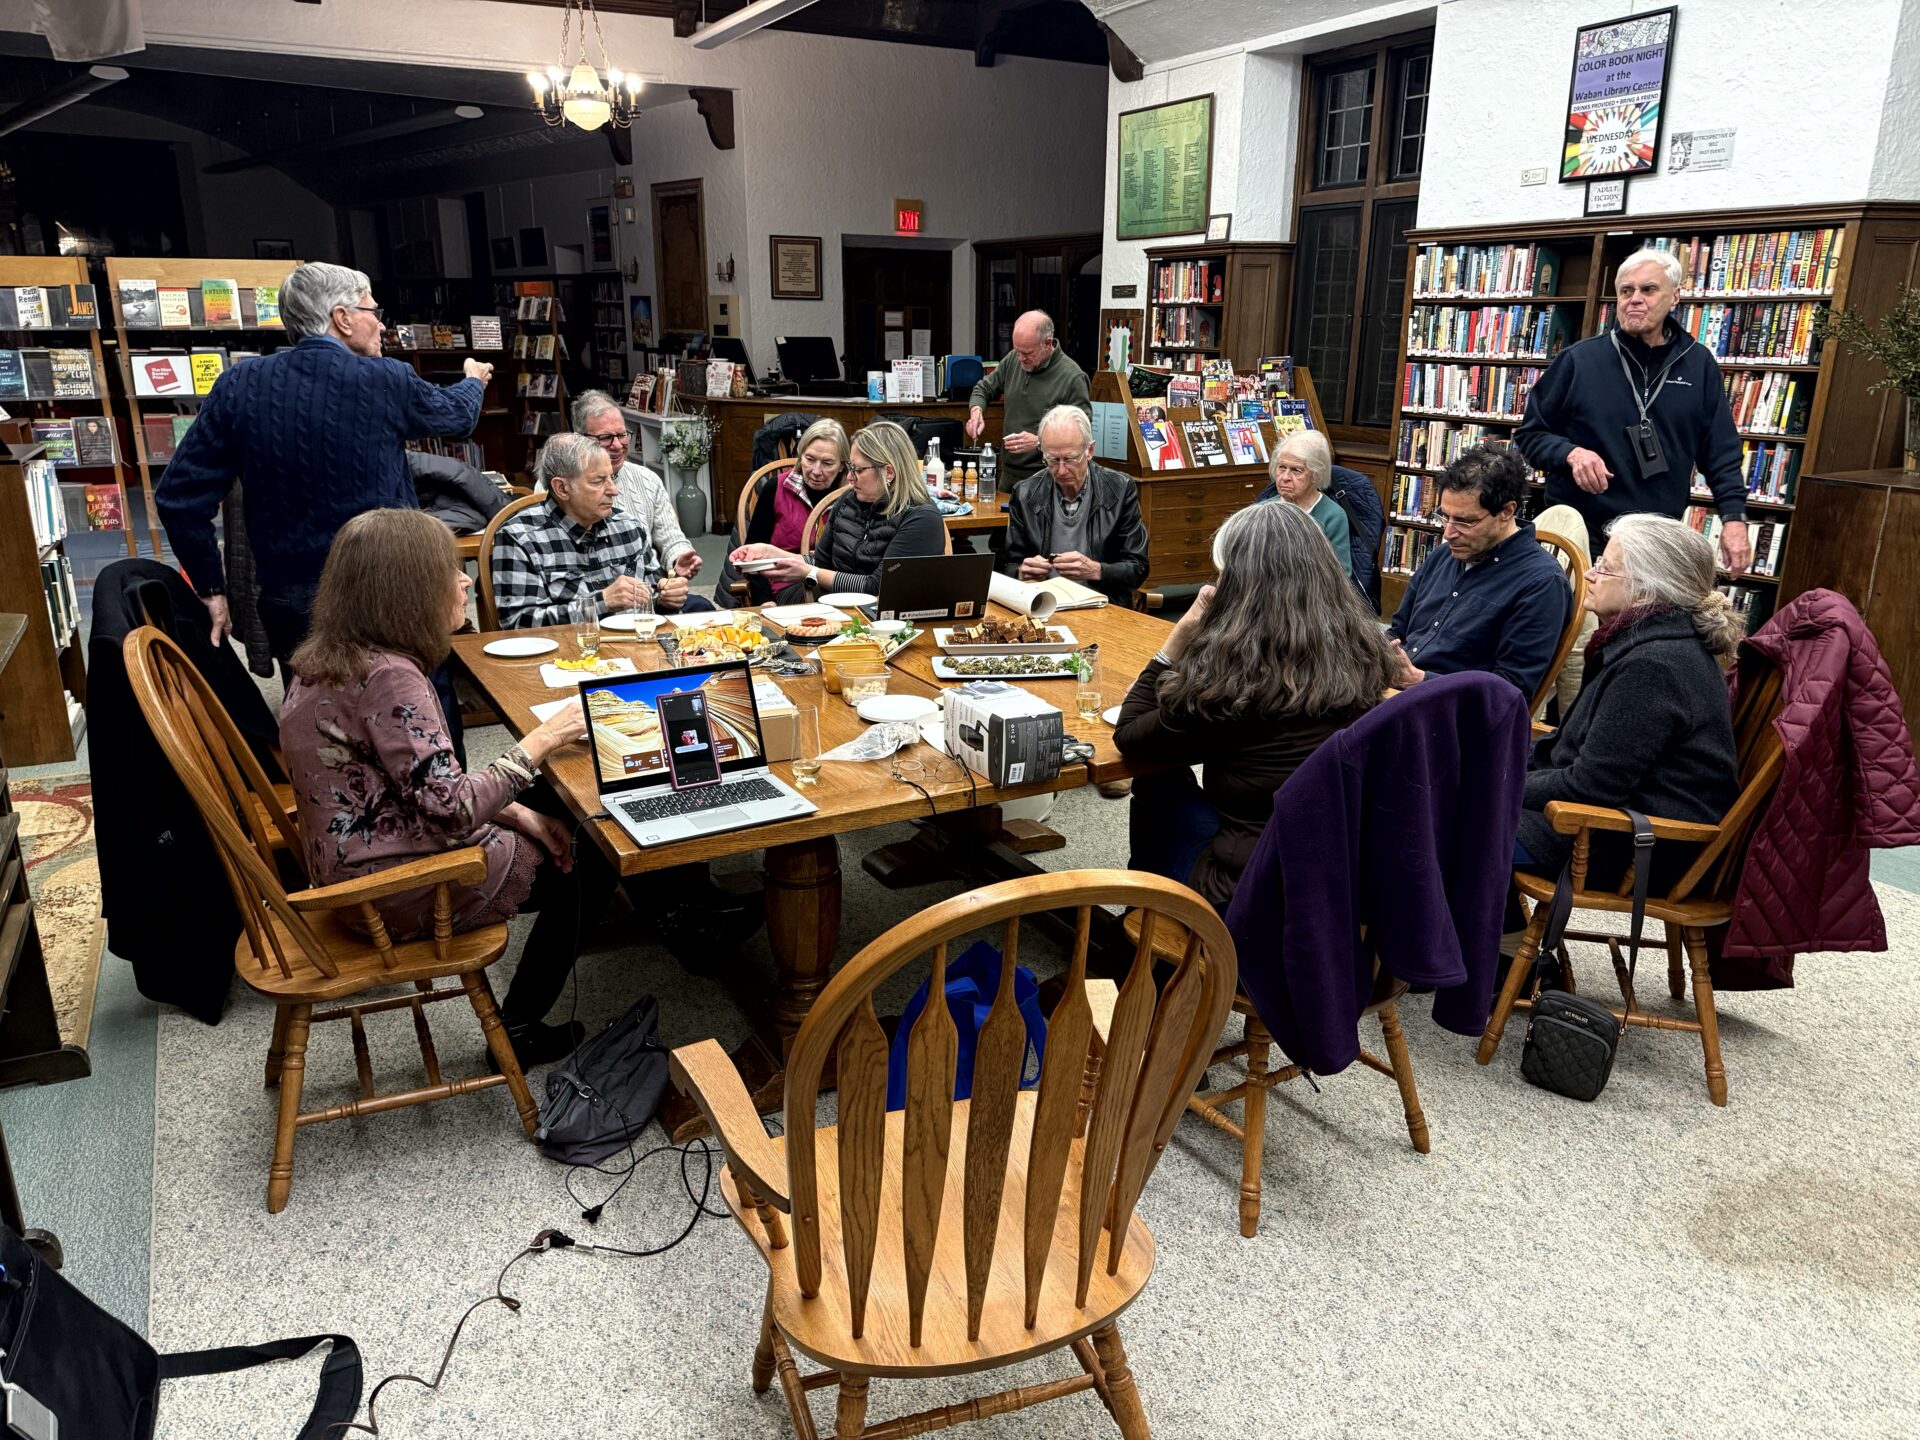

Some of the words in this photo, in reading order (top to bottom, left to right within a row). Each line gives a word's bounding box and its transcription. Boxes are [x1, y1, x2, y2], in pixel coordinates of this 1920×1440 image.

[1578, 60, 1606, 72] COLOR
[1608, 54, 1635, 68] BOOK
[1636, 48, 1664, 62] NIGHT
[1606, 74, 1614, 82] at
[1617, 70, 1631, 80] the
[1576, 90, 1602, 101] Waban
[1604, 85, 1631, 96] Library
[1632, 81, 1660, 92] Center
[1592, 100, 1616, 108] PROVIDED
[1586, 130, 1635, 143] WEDNESDAY
[1600, 145, 1616, 154] 7:30
[900, 210, 919, 230] EXIT
[72, 370, 90, 379] CLAY
[1186, 424, 1218, 433] Boon
